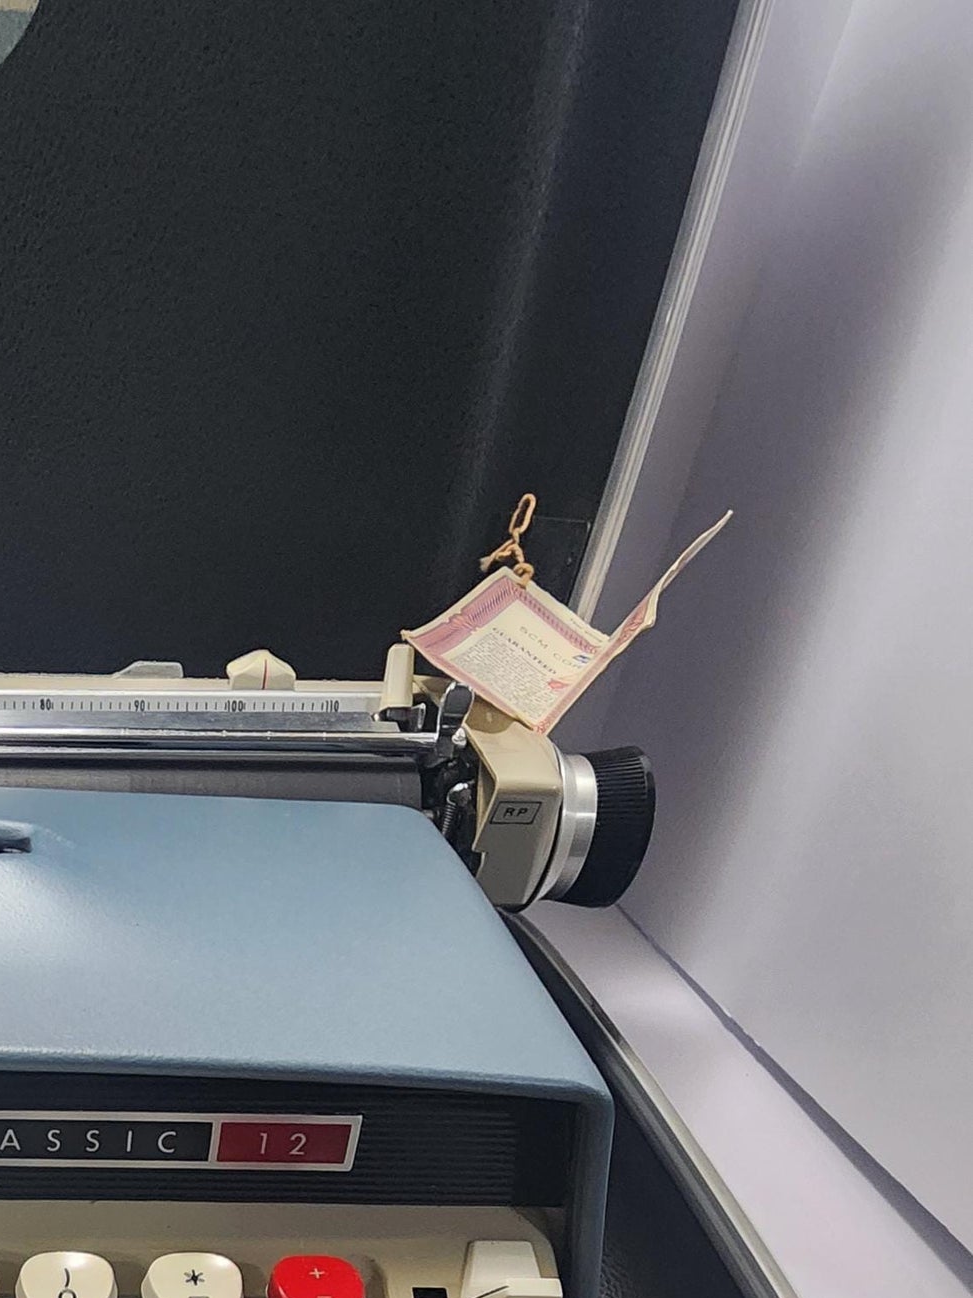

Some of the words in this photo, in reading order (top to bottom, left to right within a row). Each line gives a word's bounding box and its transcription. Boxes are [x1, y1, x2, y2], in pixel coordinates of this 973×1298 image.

[520, 626, 548, 648] SCM
[40, 698, 51, 711] 80
[134, 699, 146, 712] 90
[227, 699, 244, 712] 100
[325, 699, 340, 712] 110
[503, 807, 528, 818] RP
[257, 1132, 307, 1157] 12
[309, 1267, 325, 1279] +
